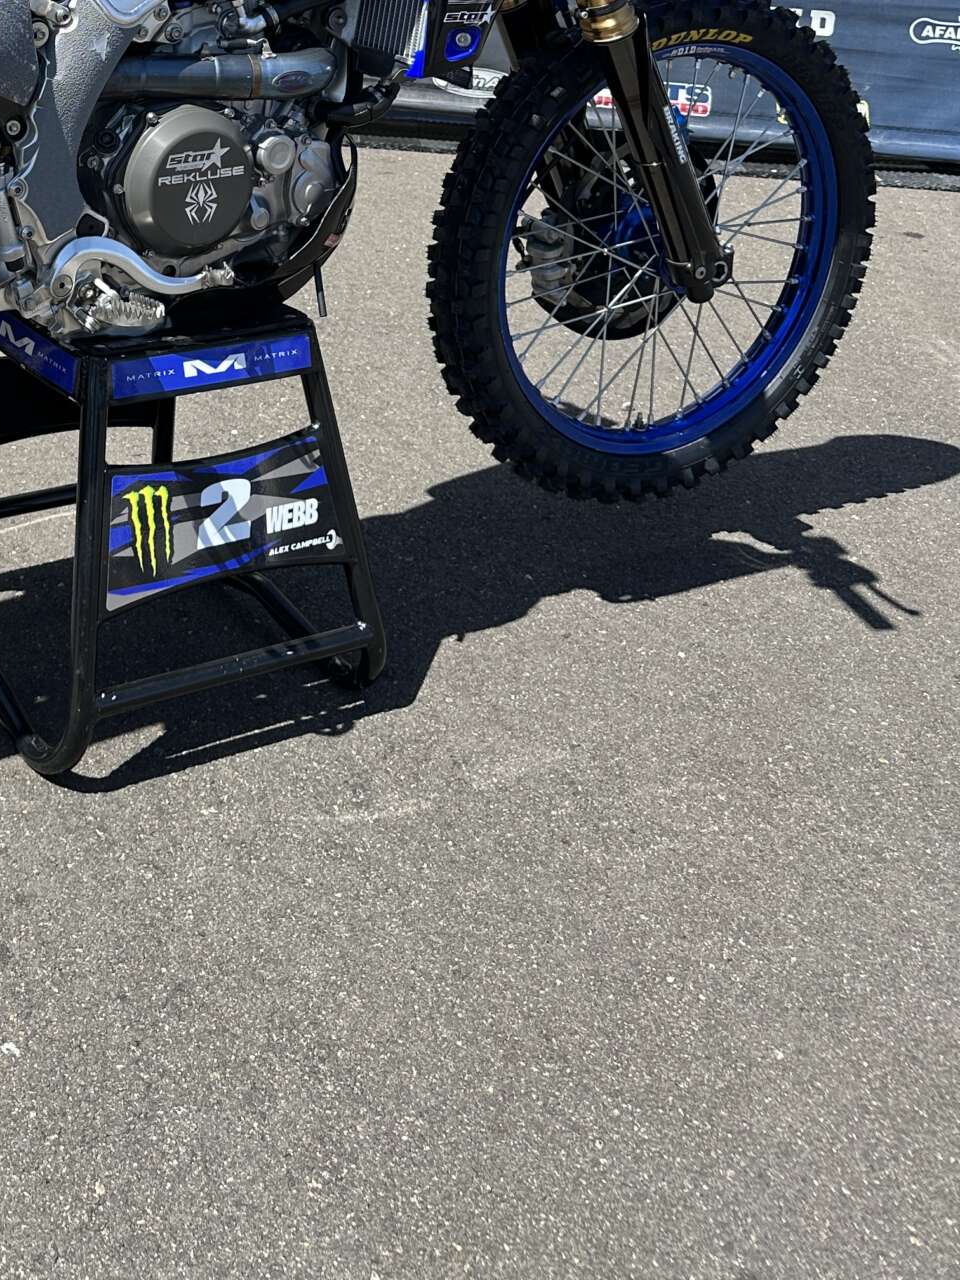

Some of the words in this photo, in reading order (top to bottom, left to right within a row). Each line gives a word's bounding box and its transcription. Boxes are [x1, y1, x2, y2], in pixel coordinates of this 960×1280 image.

[650, 28, 753, 51] DUNLOP
[158, 165, 245, 187] REKLUSE
[126, 368, 176, 383] MATRIX
[253, 348, 300, 362] MATRIX
[196, 478, 252, 551] 2
[265, 497, 319, 535] WEBB
[268, 542, 290, 557] ALEX
[291, 535, 331, 552] CAMPBELL
